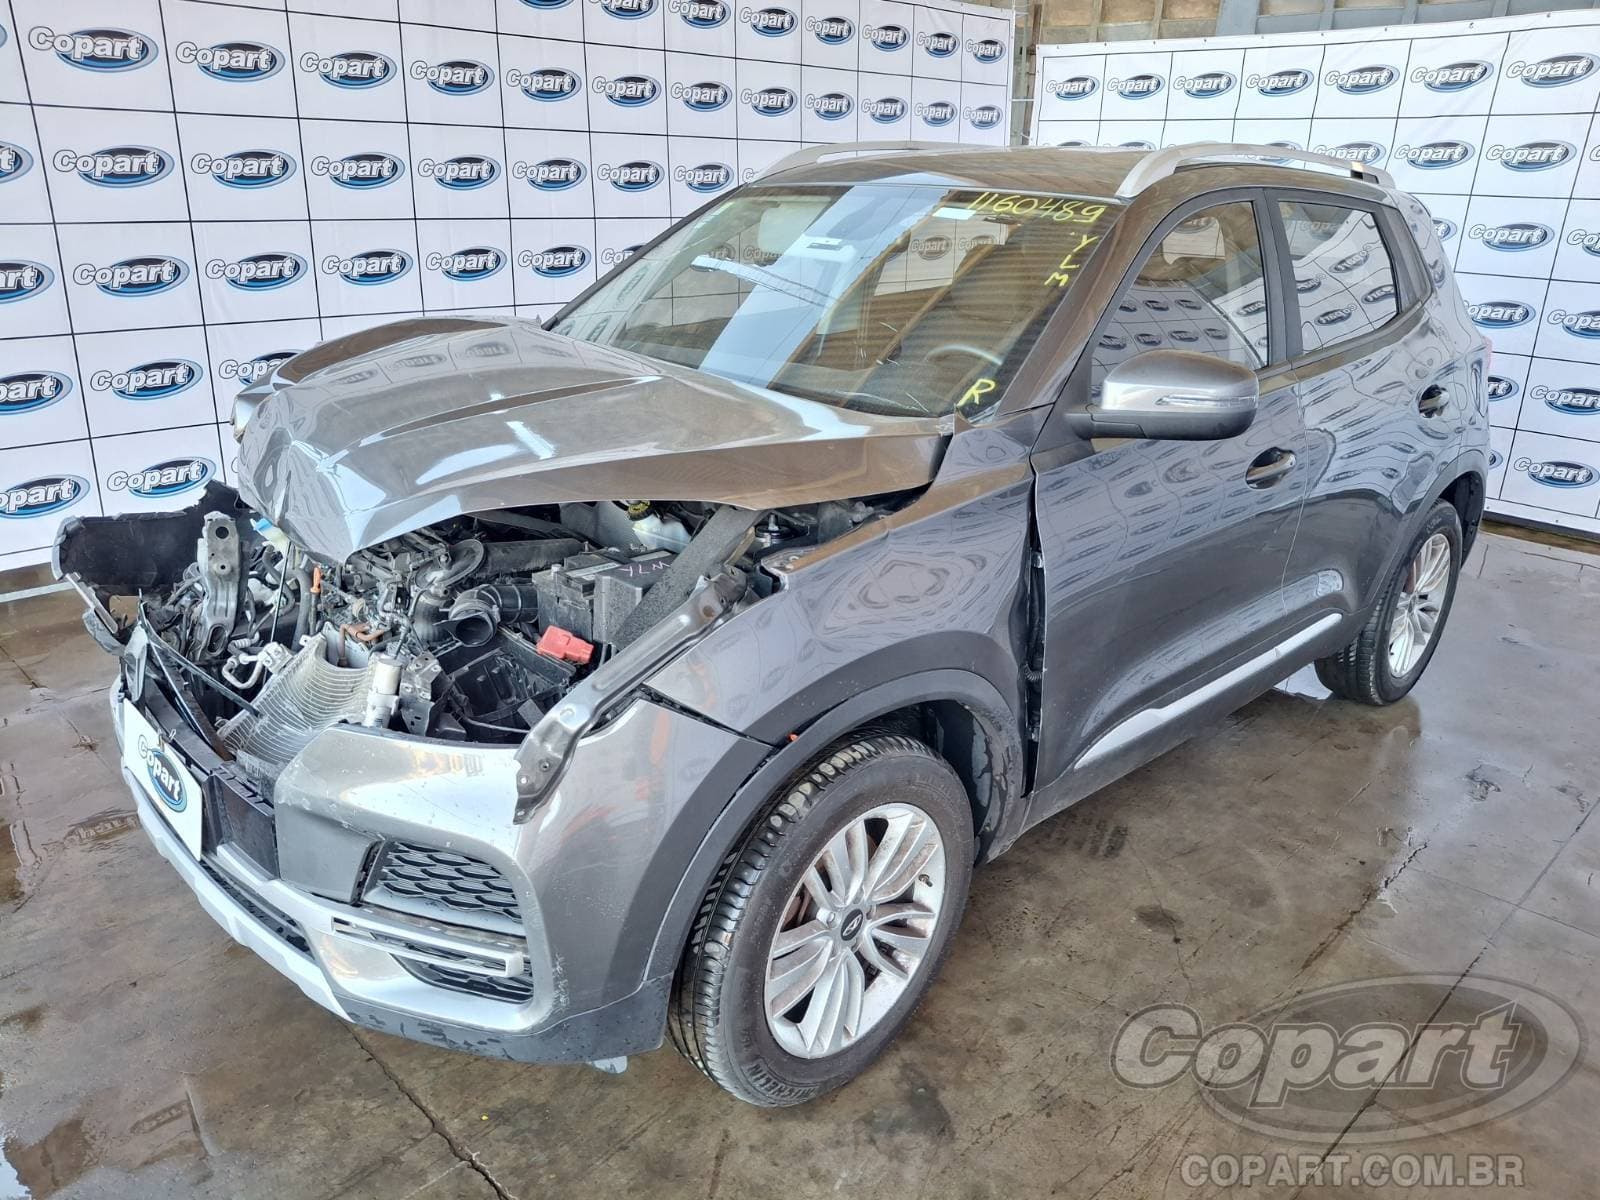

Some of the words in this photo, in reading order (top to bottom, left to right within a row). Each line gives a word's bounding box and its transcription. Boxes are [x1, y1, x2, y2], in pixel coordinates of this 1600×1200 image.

[668, 0, 723, 19] Copart
[740, 6, 791, 29] Copart
[805, 16, 848, 37] Copart
[862, 24, 903, 44] Copart
[29, 26, 142, 60] Copart
[916, 31, 955, 50] Copart
[965, 38, 1001, 56] Copart
[176, 41, 271, 70] Copart
[300, 52, 384, 77] Copart
[410, 60, 485, 86] Copart
[506, 68, 573, 93] Copart
[1246, 67, 1307, 91] Copart
[1325, 67, 1393, 89] Copart
[1411, 62, 1487, 86] Copart
[1506, 56, 1593, 82] Copart
[592, 76, 653, 98] Copart
[671, 82, 725, 103] Copart
[1046, 77, 1093, 95] Copart
[1107, 74, 1158, 93] Copart
[1173, 73, 1230, 93] Copart
[741, 88, 790, 109] Copart
[805, 94, 849, 113] Copart
[861, 99, 904, 117] Copart
[915, 103, 952, 121] Copart
[963, 107, 998, 124] Copart
[53, 149, 160, 178] Copart
[1394, 142, 1468, 162] Copart
[1486, 143, 1568, 165] Copart
[191, 153, 286, 179] Copart
[311, 156, 394, 180] Copart
[418, 158, 491, 181] Copart
[512, 161, 578, 182] Copart
[597, 164, 656, 184] Copart
[674, 165, 728, 184] Copart
[1469, 224, 1547, 245] Copart
[205, 256, 296, 282] Copart
[322, 252, 403, 277] Copart
[426, 248, 500, 273] Copart
[518, 246, 585, 269] Copart
[73, 260, 176, 289] Copart
[1463, 301, 1528, 321] opart
[90, 362, 190, 392] Copart
[219, 359, 282, 382] Cop
[0, 375, 56, 402] art
[1530, 385, 1600, 410] Copar
[107, 459, 202, 491] Copart
[1514, 456, 1593, 482] Copart
[0, 478, 74, 513] part
[138, 734, 182, 801] Copart
